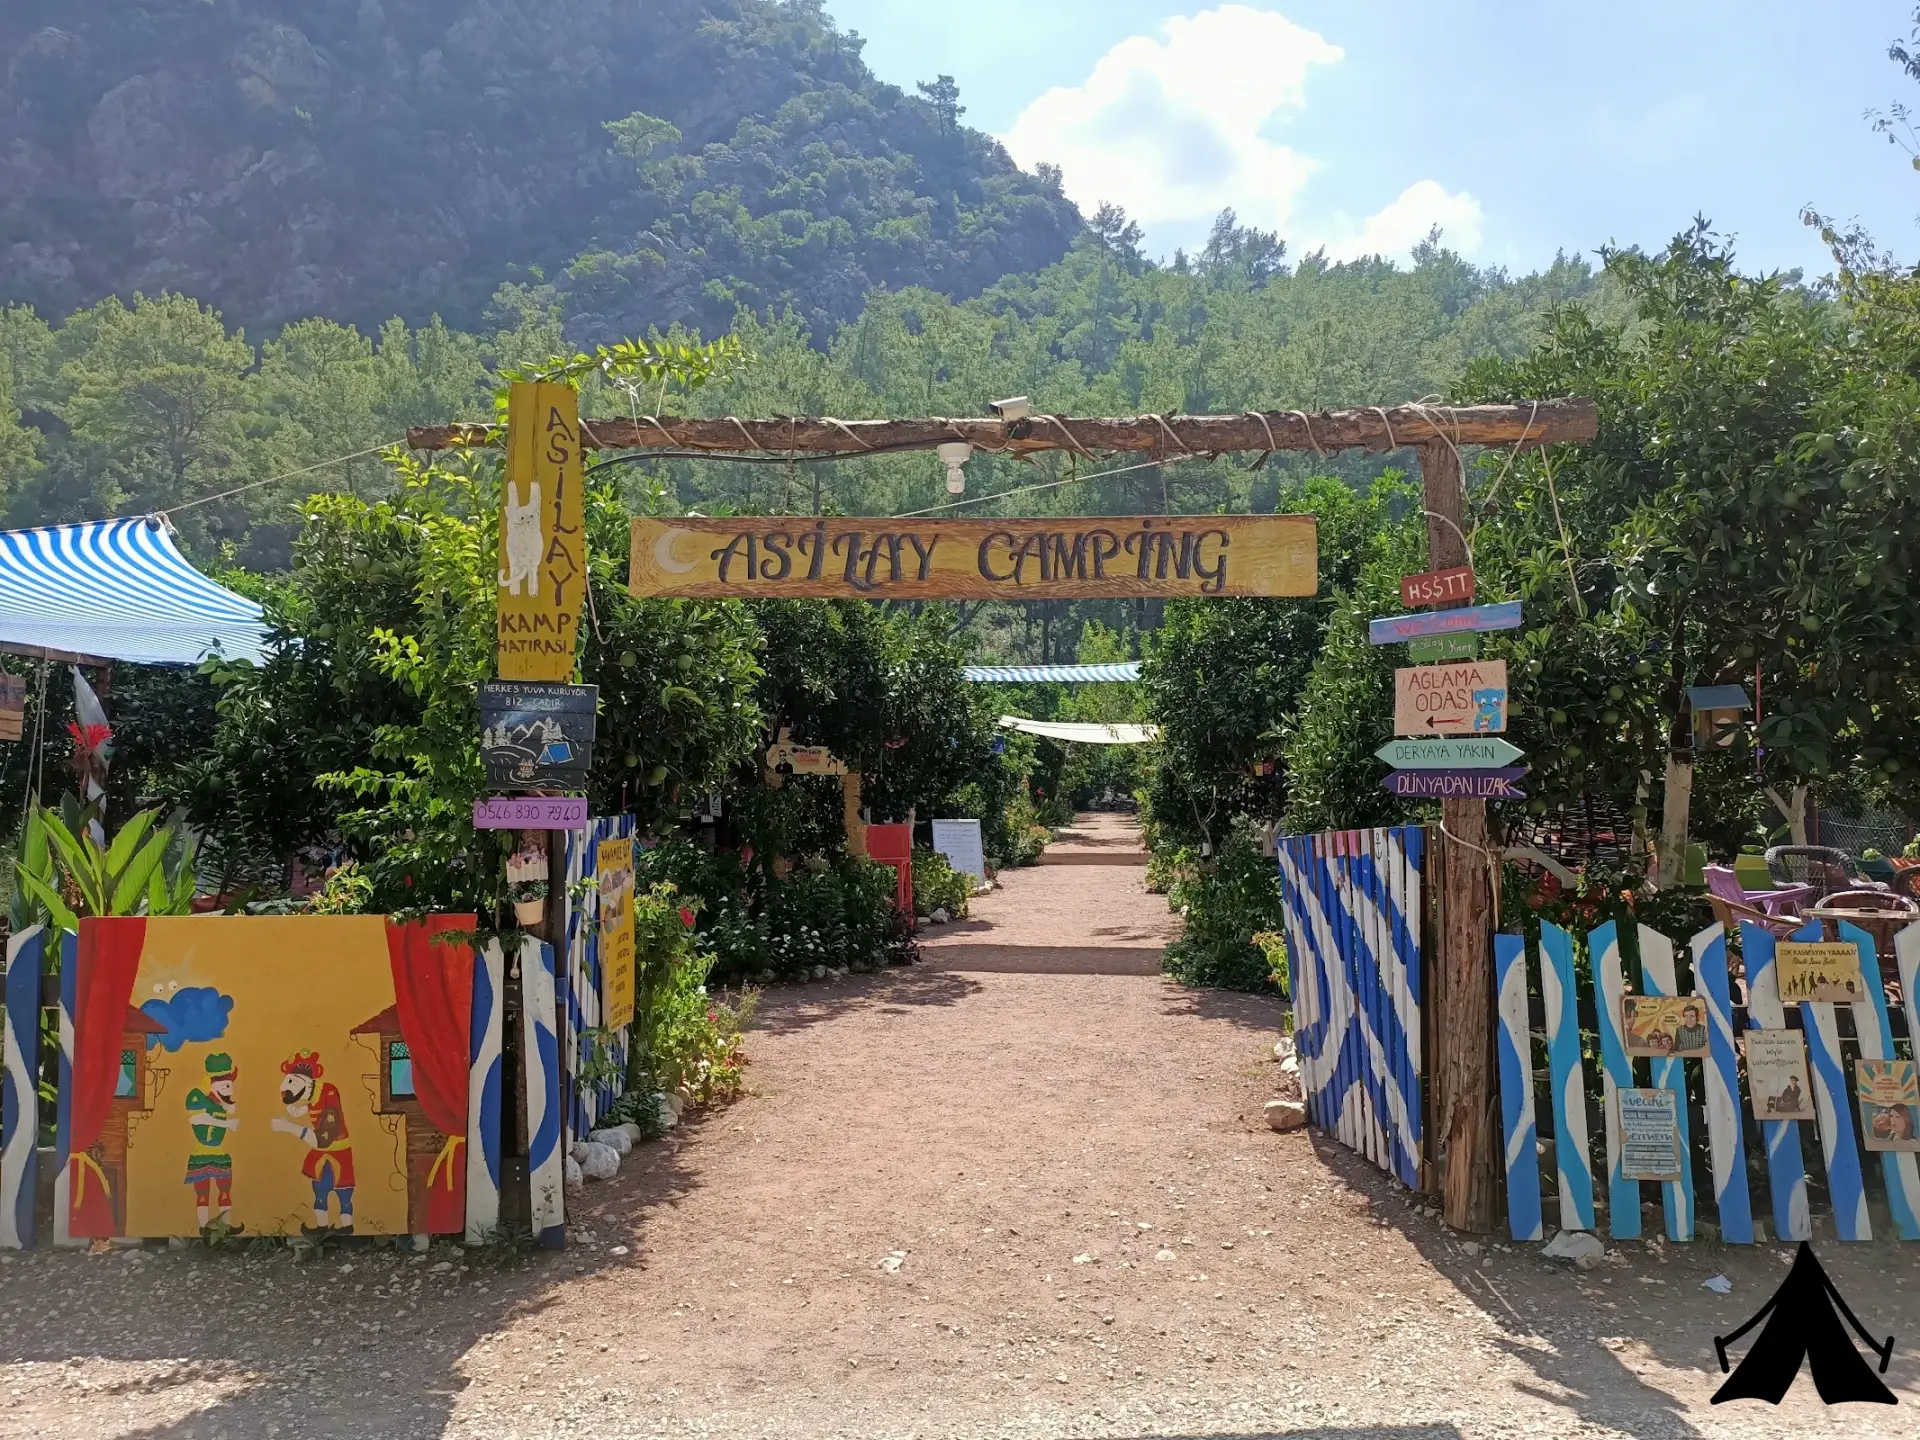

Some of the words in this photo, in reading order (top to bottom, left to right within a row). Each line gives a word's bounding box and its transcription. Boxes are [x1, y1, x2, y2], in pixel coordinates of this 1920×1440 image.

[500, 611, 572, 635] KAMP
[496, 638, 567, 657] HATIRASI
[483, 684, 520, 694] HERKES
[522, 685, 546, 695] YUVA
[548, 686, 588, 697] KURUYOR
[1415, 688, 1475, 712] ODASI
[1395, 744, 1451, 760] DERYAYA
[1456, 744, 1495, 760] YAKIN
[1396, 772, 1473, 794] DÜNYADAN
[1477, 777, 1511, 796] UZAK
[476, 804, 512, 820] 0546
[515, 805, 540, 820] 890
[546, 804, 581, 822] 7940
